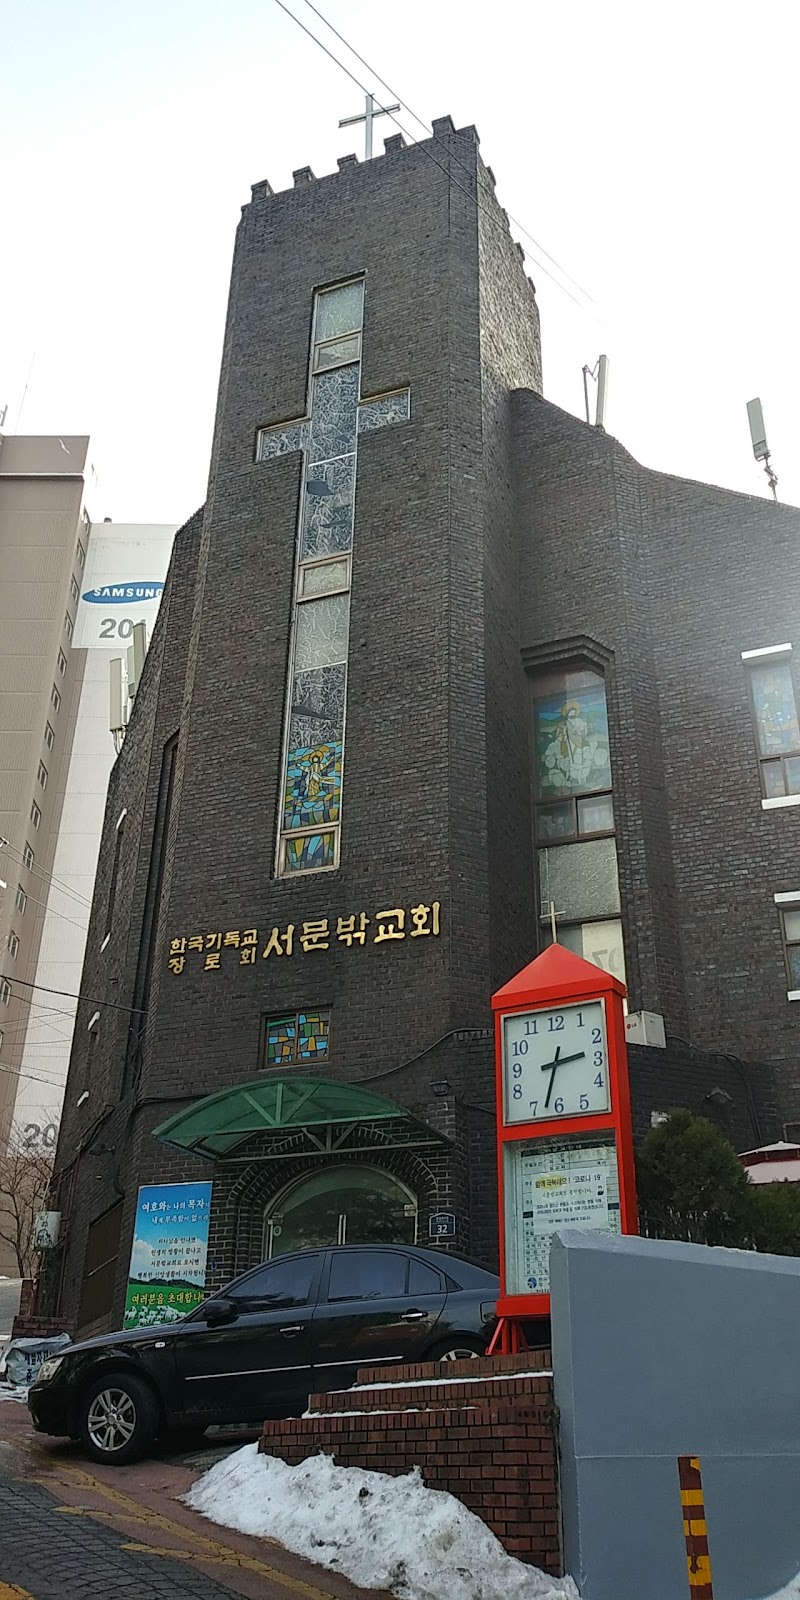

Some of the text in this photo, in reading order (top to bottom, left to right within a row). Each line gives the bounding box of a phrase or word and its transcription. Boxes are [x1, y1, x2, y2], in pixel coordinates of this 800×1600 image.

[93, 587, 163, 598] SAMSUNG
[98, 618, 146, 639] 20
[263, 901, 441, 959] 서문밖교회
[169, 928, 259, 955] 한국기독교
[523, 1020, 539, 1036] 11
[547, 1015, 565, 1032] 12
[576, 1012, 585, 1028] 1
[591, 1028, 602, 1044] 2
[512, 1040, 529, 1057] 10
[593, 1051, 603, 1067] 3
[512, 1063, 522, 1079] 9
[593, 1072, 604, 1088] 4
[513, 1084, 523, 1100] 8
[529, 1101, 539, 1116] 7
[554, 1097, 564, 1113] 6
[579, 1093, 589, 1110] 5
[142, 1200, 172, 1213] 여호와는
[173, 1201, 186, 1211] 나의
[436, 1224, 448, 1234] 32
[151, 1248, 167, 1257] 인생의
[185, 1246, 202, 1255] 끝나고
[183, 1258, 200, 1266] 오시면
[182, 1268, 207, 1277] 시작됩니
[131, 1293, 165, 1306] 여러분을
